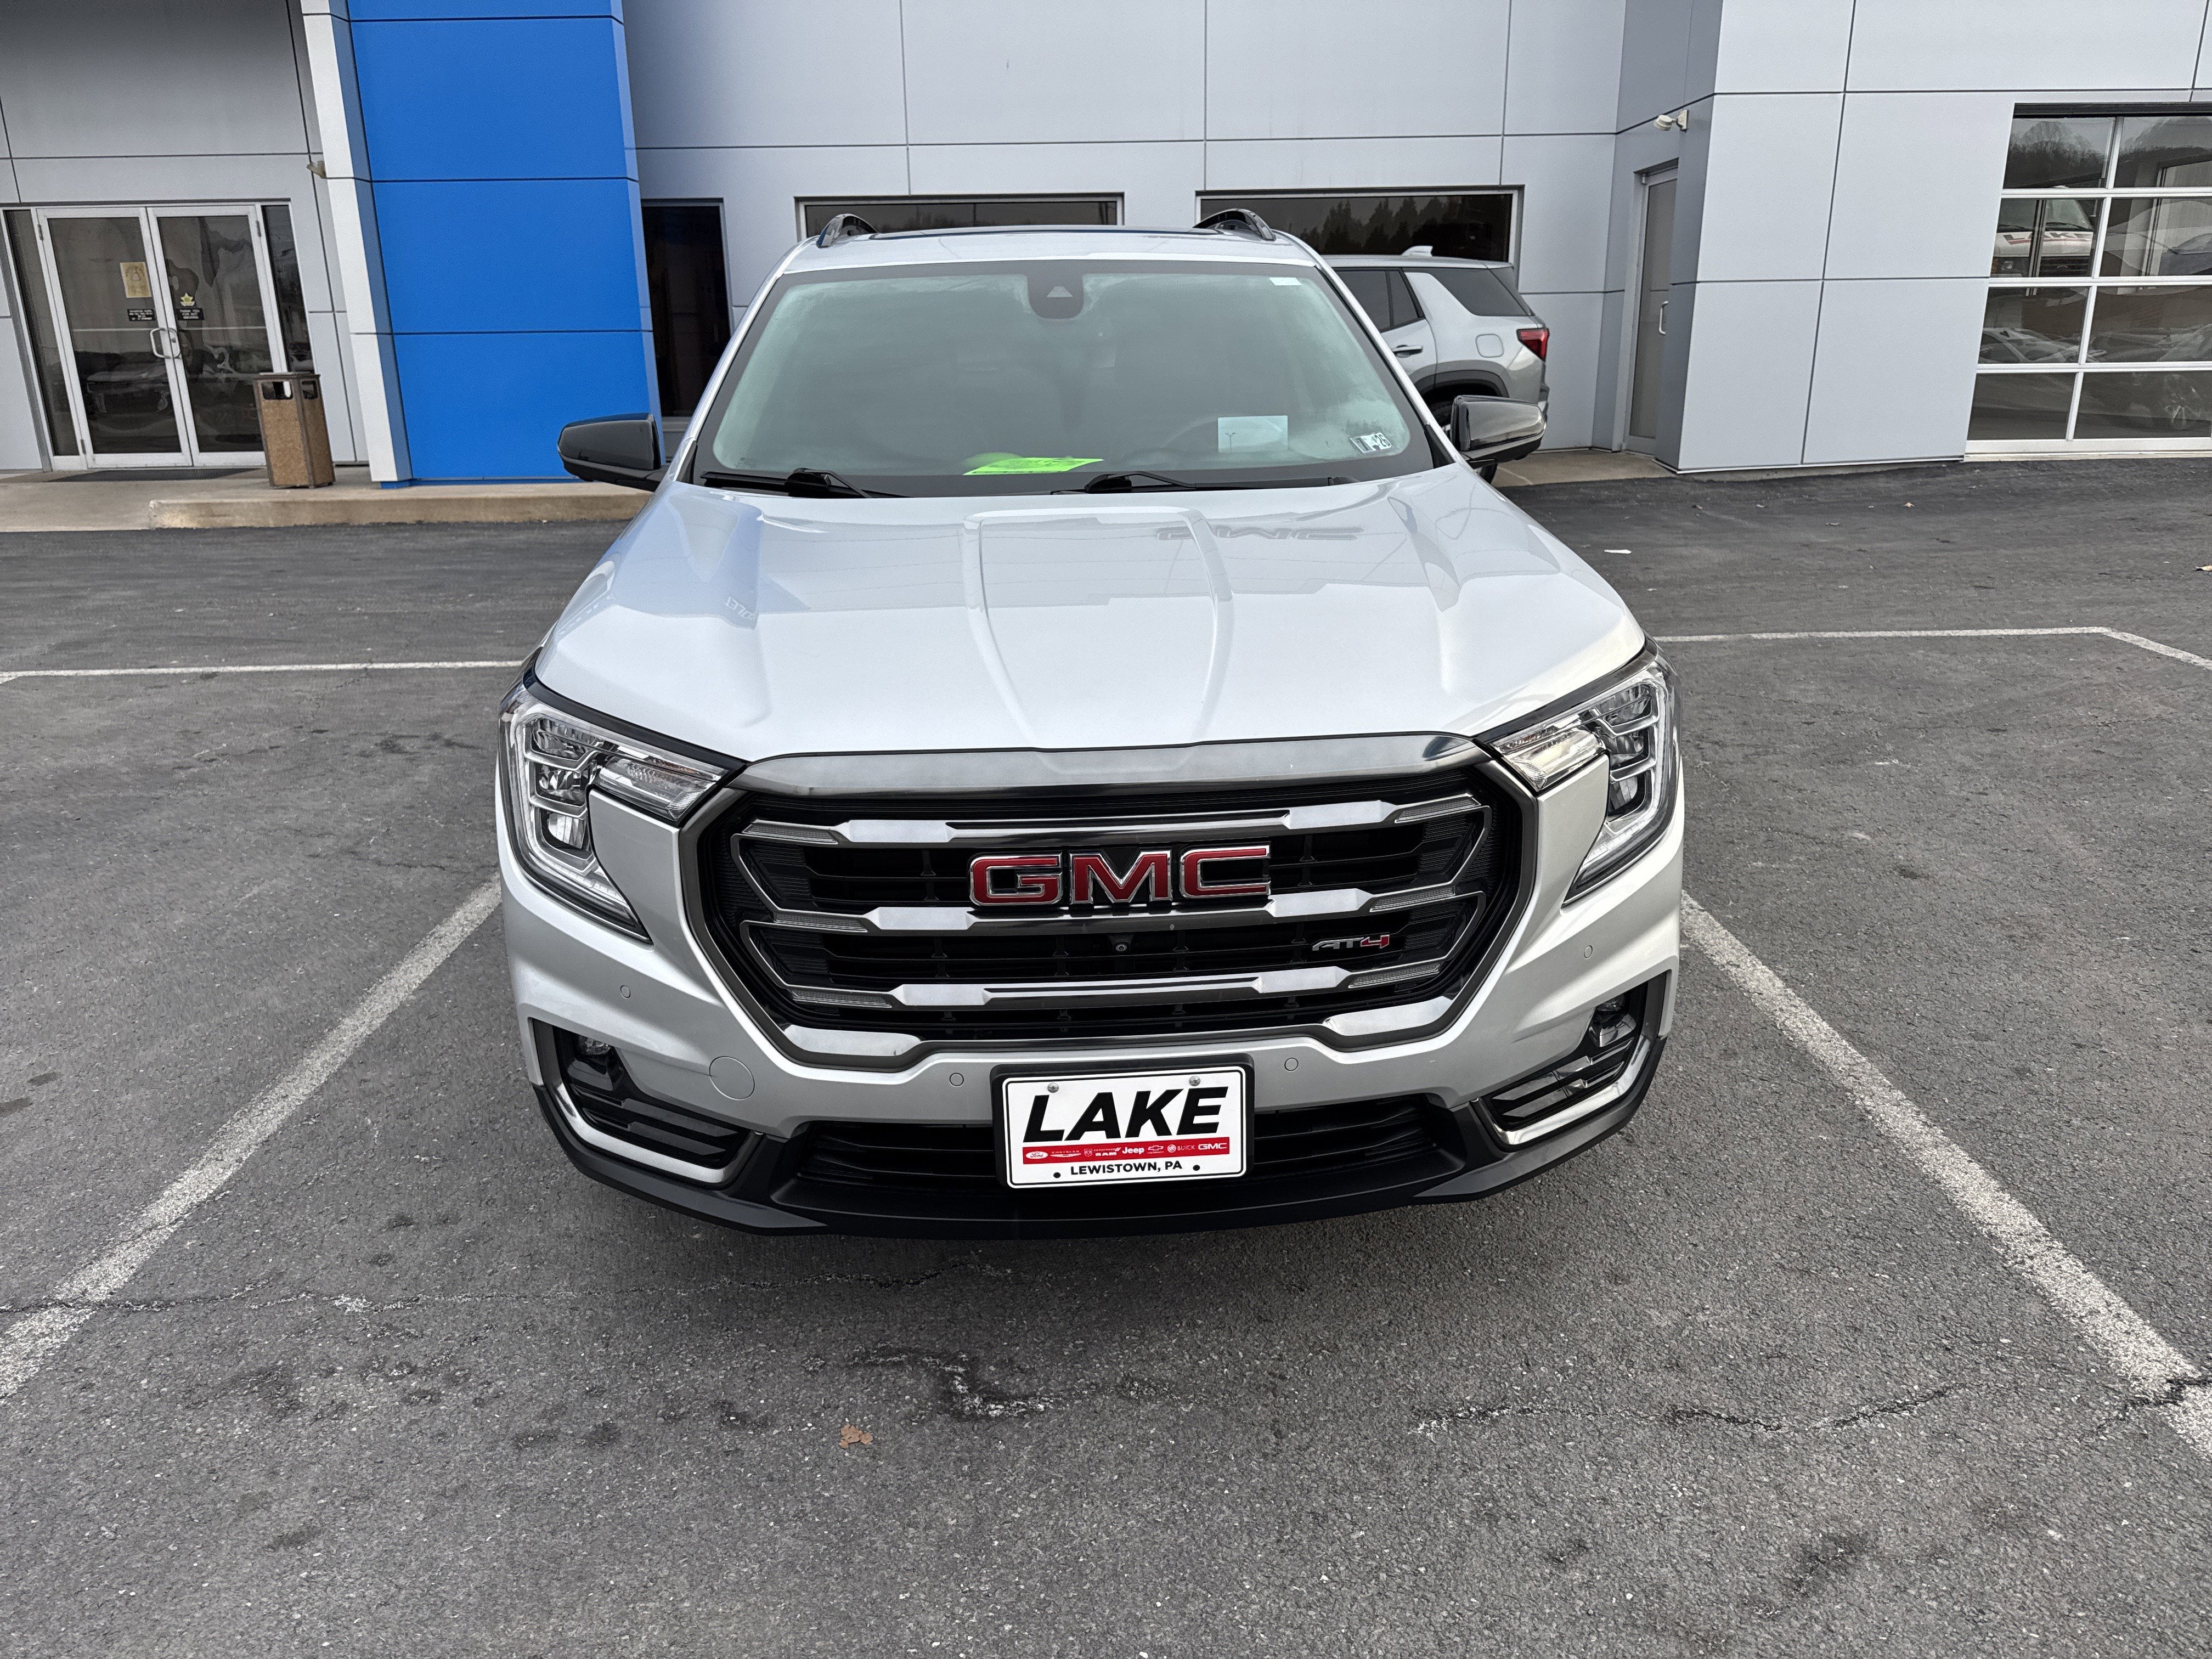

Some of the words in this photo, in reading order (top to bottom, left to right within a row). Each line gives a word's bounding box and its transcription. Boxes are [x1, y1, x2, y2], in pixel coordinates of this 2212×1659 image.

[970, 845, 1271, 906] GMC
[1312, 934, 1390, 951] AT4
[1023, 1086, 1228, 1143] LAKE
[1122, 1146, 1145, 1155] Jeep
[1070, 1161, 1161, 1175] LEWISTOWN,
[1165, 1160, 1183, 1170] PA
